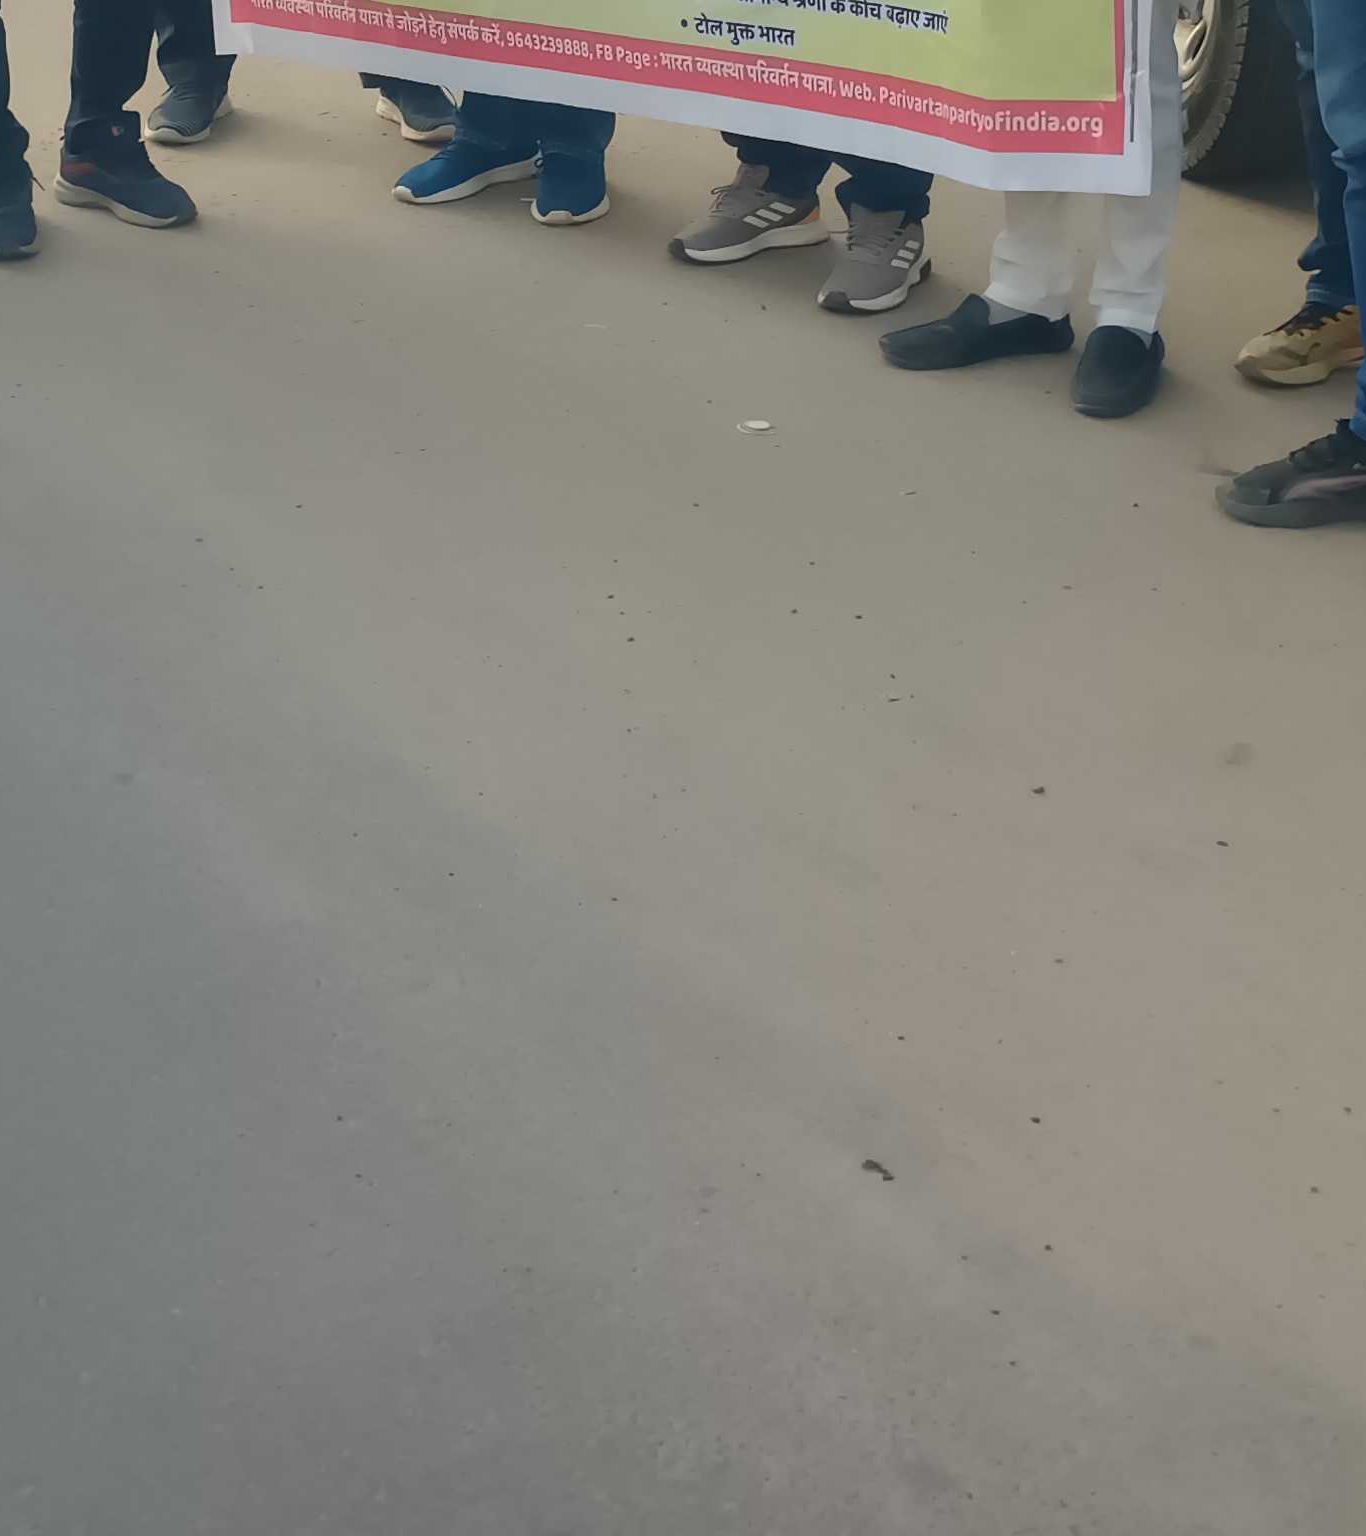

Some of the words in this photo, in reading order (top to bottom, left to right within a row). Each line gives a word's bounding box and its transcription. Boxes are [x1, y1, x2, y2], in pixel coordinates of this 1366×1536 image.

[359, 9, 384, 27] यात्रा
[384, 6, 394, 29] से
[429, 14, 447, 45] हेतु
[596, 43, 613, 61] FB
[616, 49, 651, 71] Page
[659, 51, 693, 72] भारत
[695, 56, 745, 80] व्यवस्था
[746, 59, 800, 89] परिवर्तन
[839, 79, 876, 102] Web.
[694, 13, 723, 36] टोल
[725, 21, 754, 45] मुक्त
[758, 25, 795, 46] भारत
